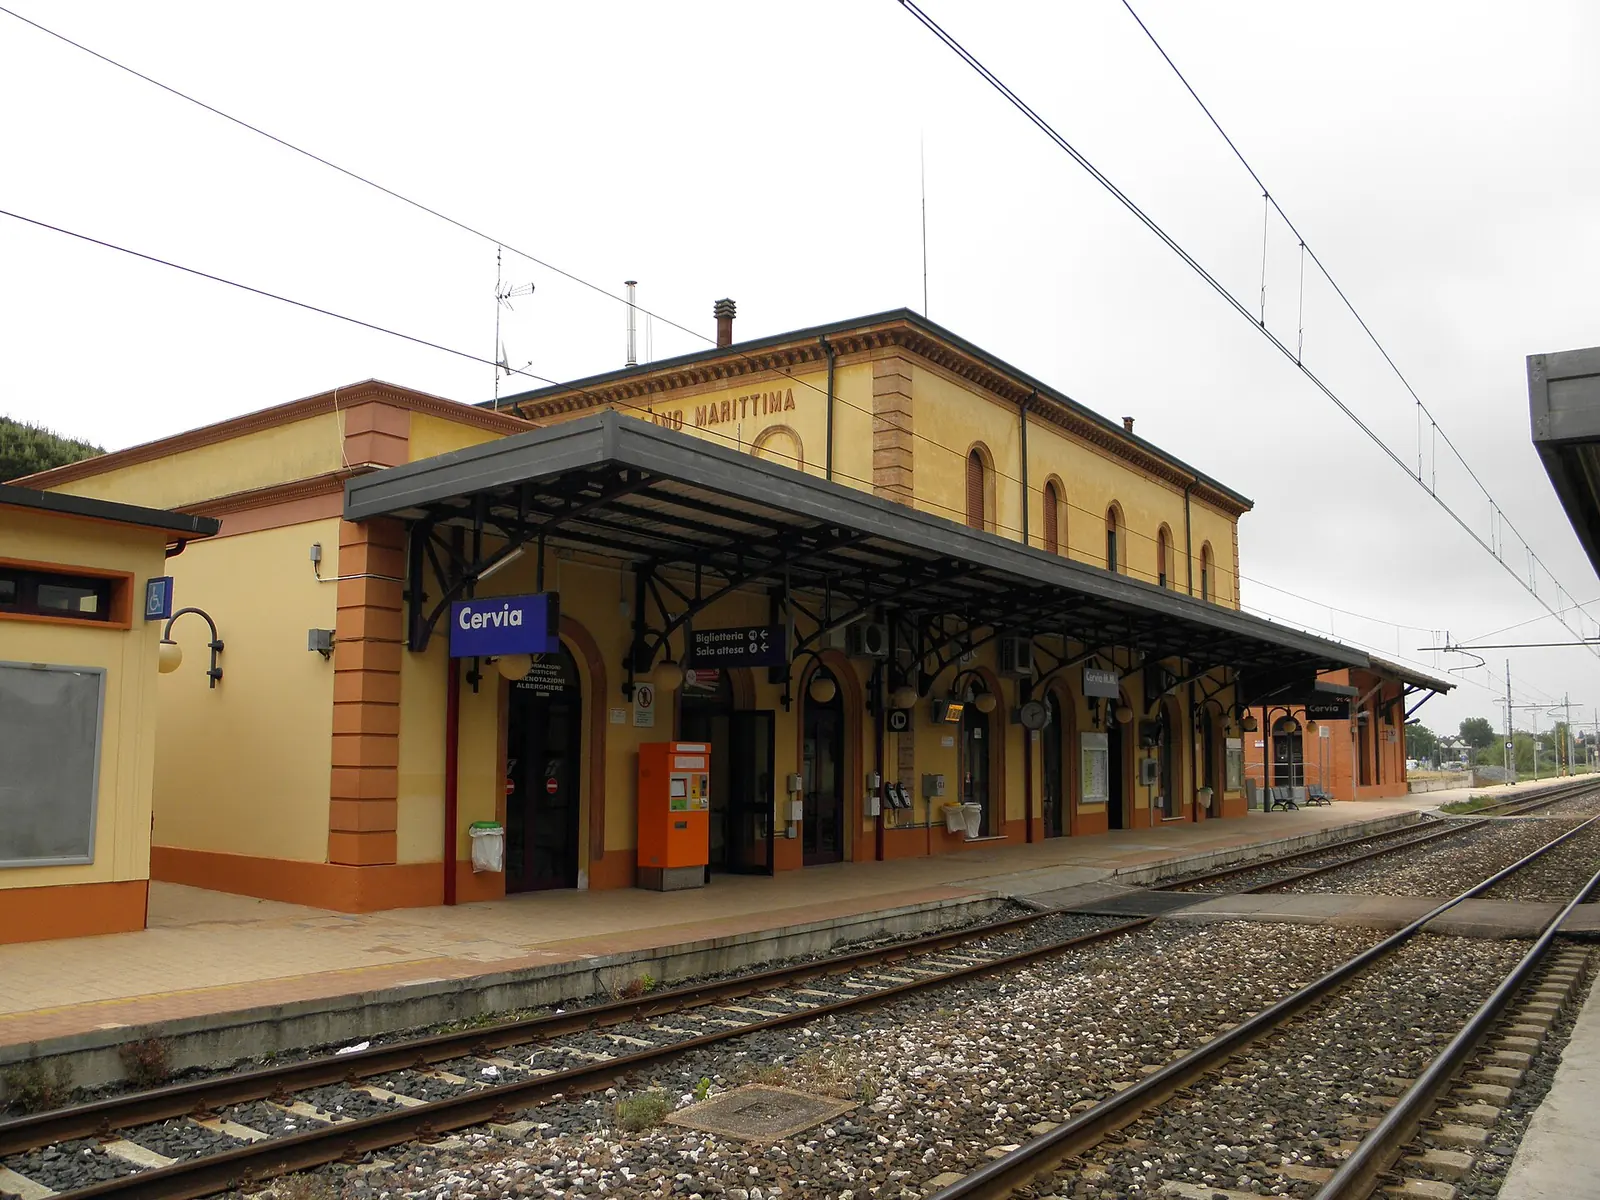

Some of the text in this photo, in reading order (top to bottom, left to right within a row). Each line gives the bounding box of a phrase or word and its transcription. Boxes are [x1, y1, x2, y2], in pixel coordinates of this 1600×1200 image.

[694, 388, 795, 426] MARITTIMA
[459, 603, 523, 630] Cervia
[695, 631, 744, 644] Biglietteria
[695, 646, 745, 656] Sala attesa
[1085, 670, 1103, 683] Cervia
[516, 682, 564, 691] ALBERGHIERE
[1309, 703, 1340, 713] Cervia
